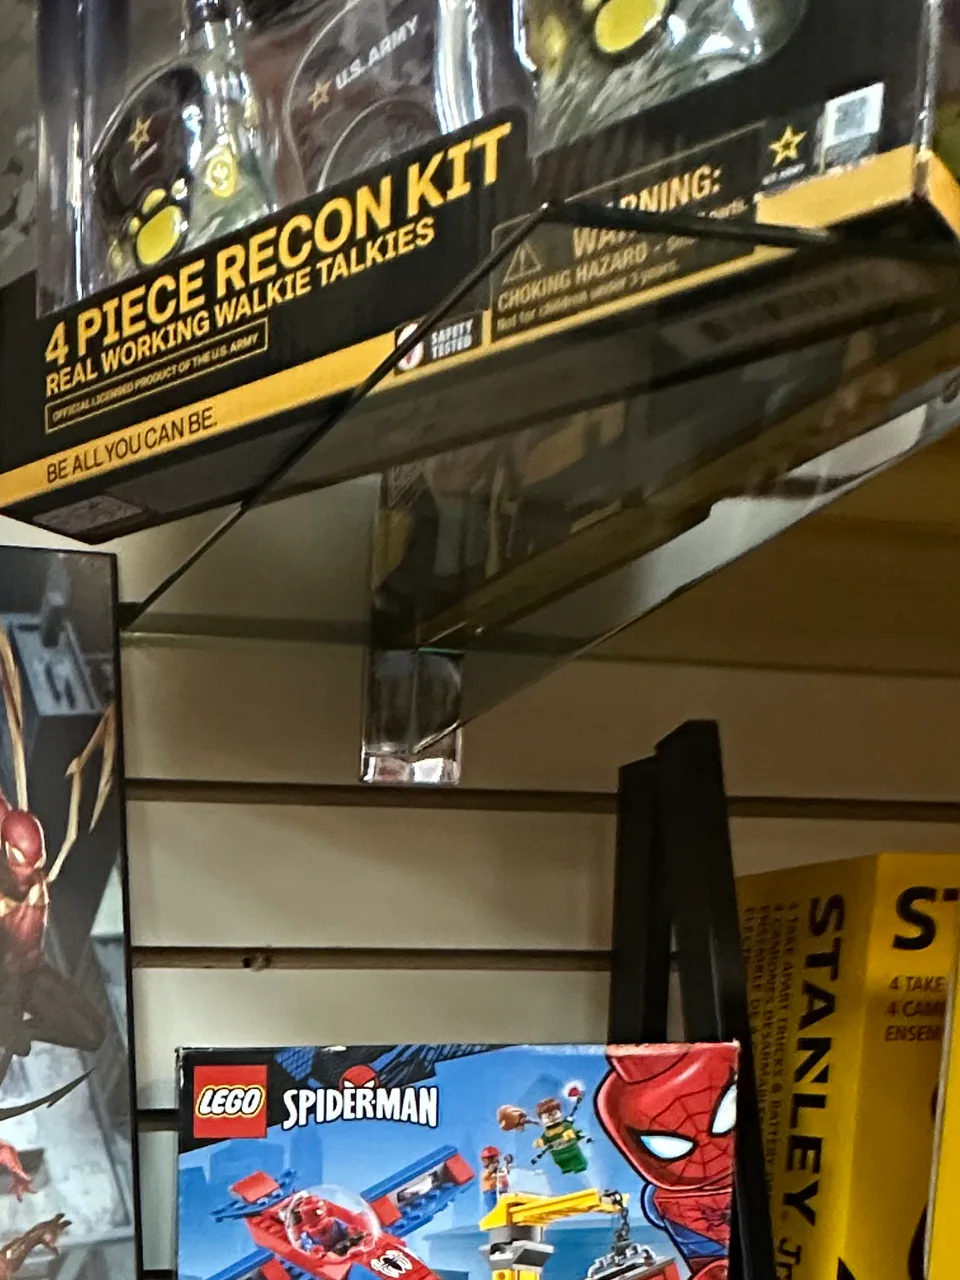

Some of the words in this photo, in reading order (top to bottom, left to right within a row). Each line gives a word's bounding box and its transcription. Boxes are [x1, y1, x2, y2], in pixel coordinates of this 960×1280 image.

[368, 14, 418, 67] ARMY
[45, 321, 69, 366] 4
[77, 259, 205, 357] PIECE
[217, 175, 392, 297] RECON
[407, 122, 512, 217] KIT
[46, 357, 98, 397] REAL
[101, 309, 210, 374] WORKING
[214, 267, 311, 329] WALKIE
[316, 216, 435, 288] TALKIES
[497, 269, 572, 313] CHOKING
[575, 243, 649, 284] HAZARD
[431, 318, 473, 345] SAFETY
[432, 334, 472, 360] TESTED
[134, 363, 178, 391] PRODUCT
[178, 359, 191, 374] OF
[192, 351, 211, 369] THE
[229, 332, 259, 354] ARMY
[47, 457, 69, 484] BE
[72, 449, 104, 475] ALL
[105, 432, 141, 463] YOU
[144, 416, 185, 449] CAN
[188, 406, 218, 435] BE.
[905, 976, 945, 992] TAKE
[782, 894, 846, 1226] STANLEY
[197, 1086, 264, 1116] LEGO
